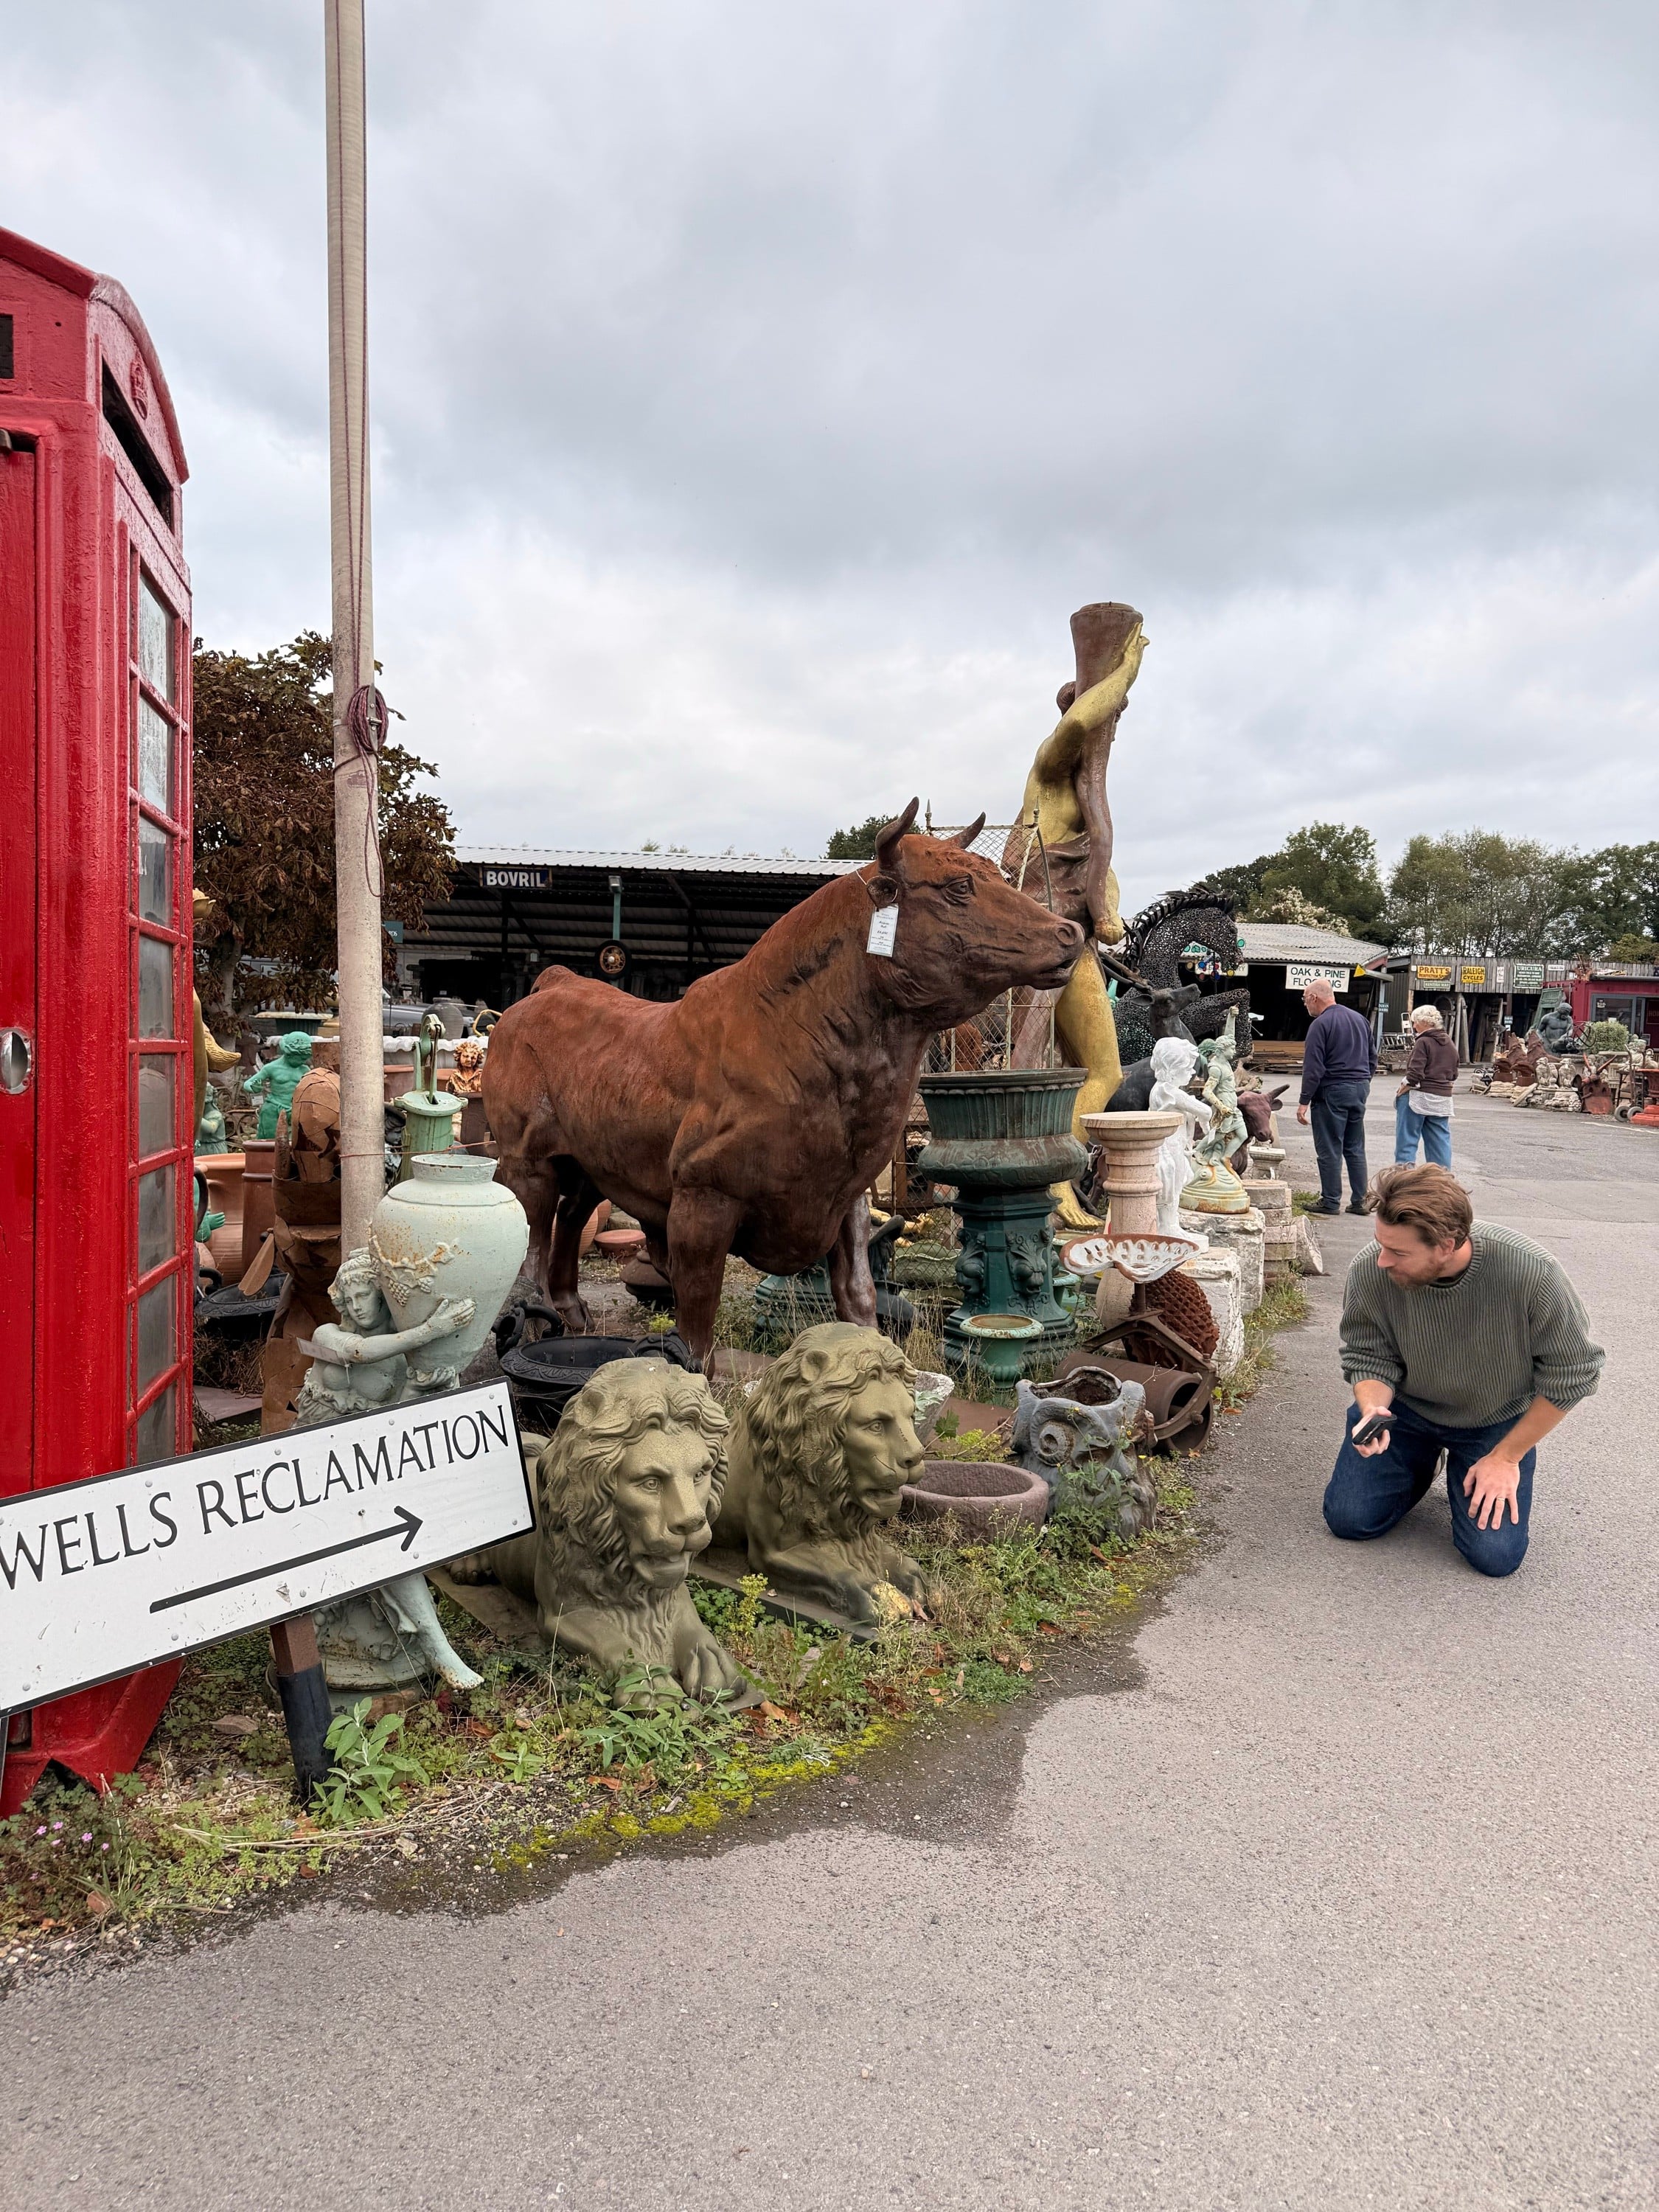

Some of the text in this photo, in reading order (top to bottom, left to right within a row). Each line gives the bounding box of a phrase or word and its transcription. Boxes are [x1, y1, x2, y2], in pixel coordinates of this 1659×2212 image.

[486, 871, 547, 887] BOVRIL
[1290, 967, 1346, 978] OAK & PINE
[1419, 966, 1450, 974] PRATT'S
[1463, 967, 1484, 975] RALEIGH
[0, 1405, 509, 1590] WELLS RECLAMATION
